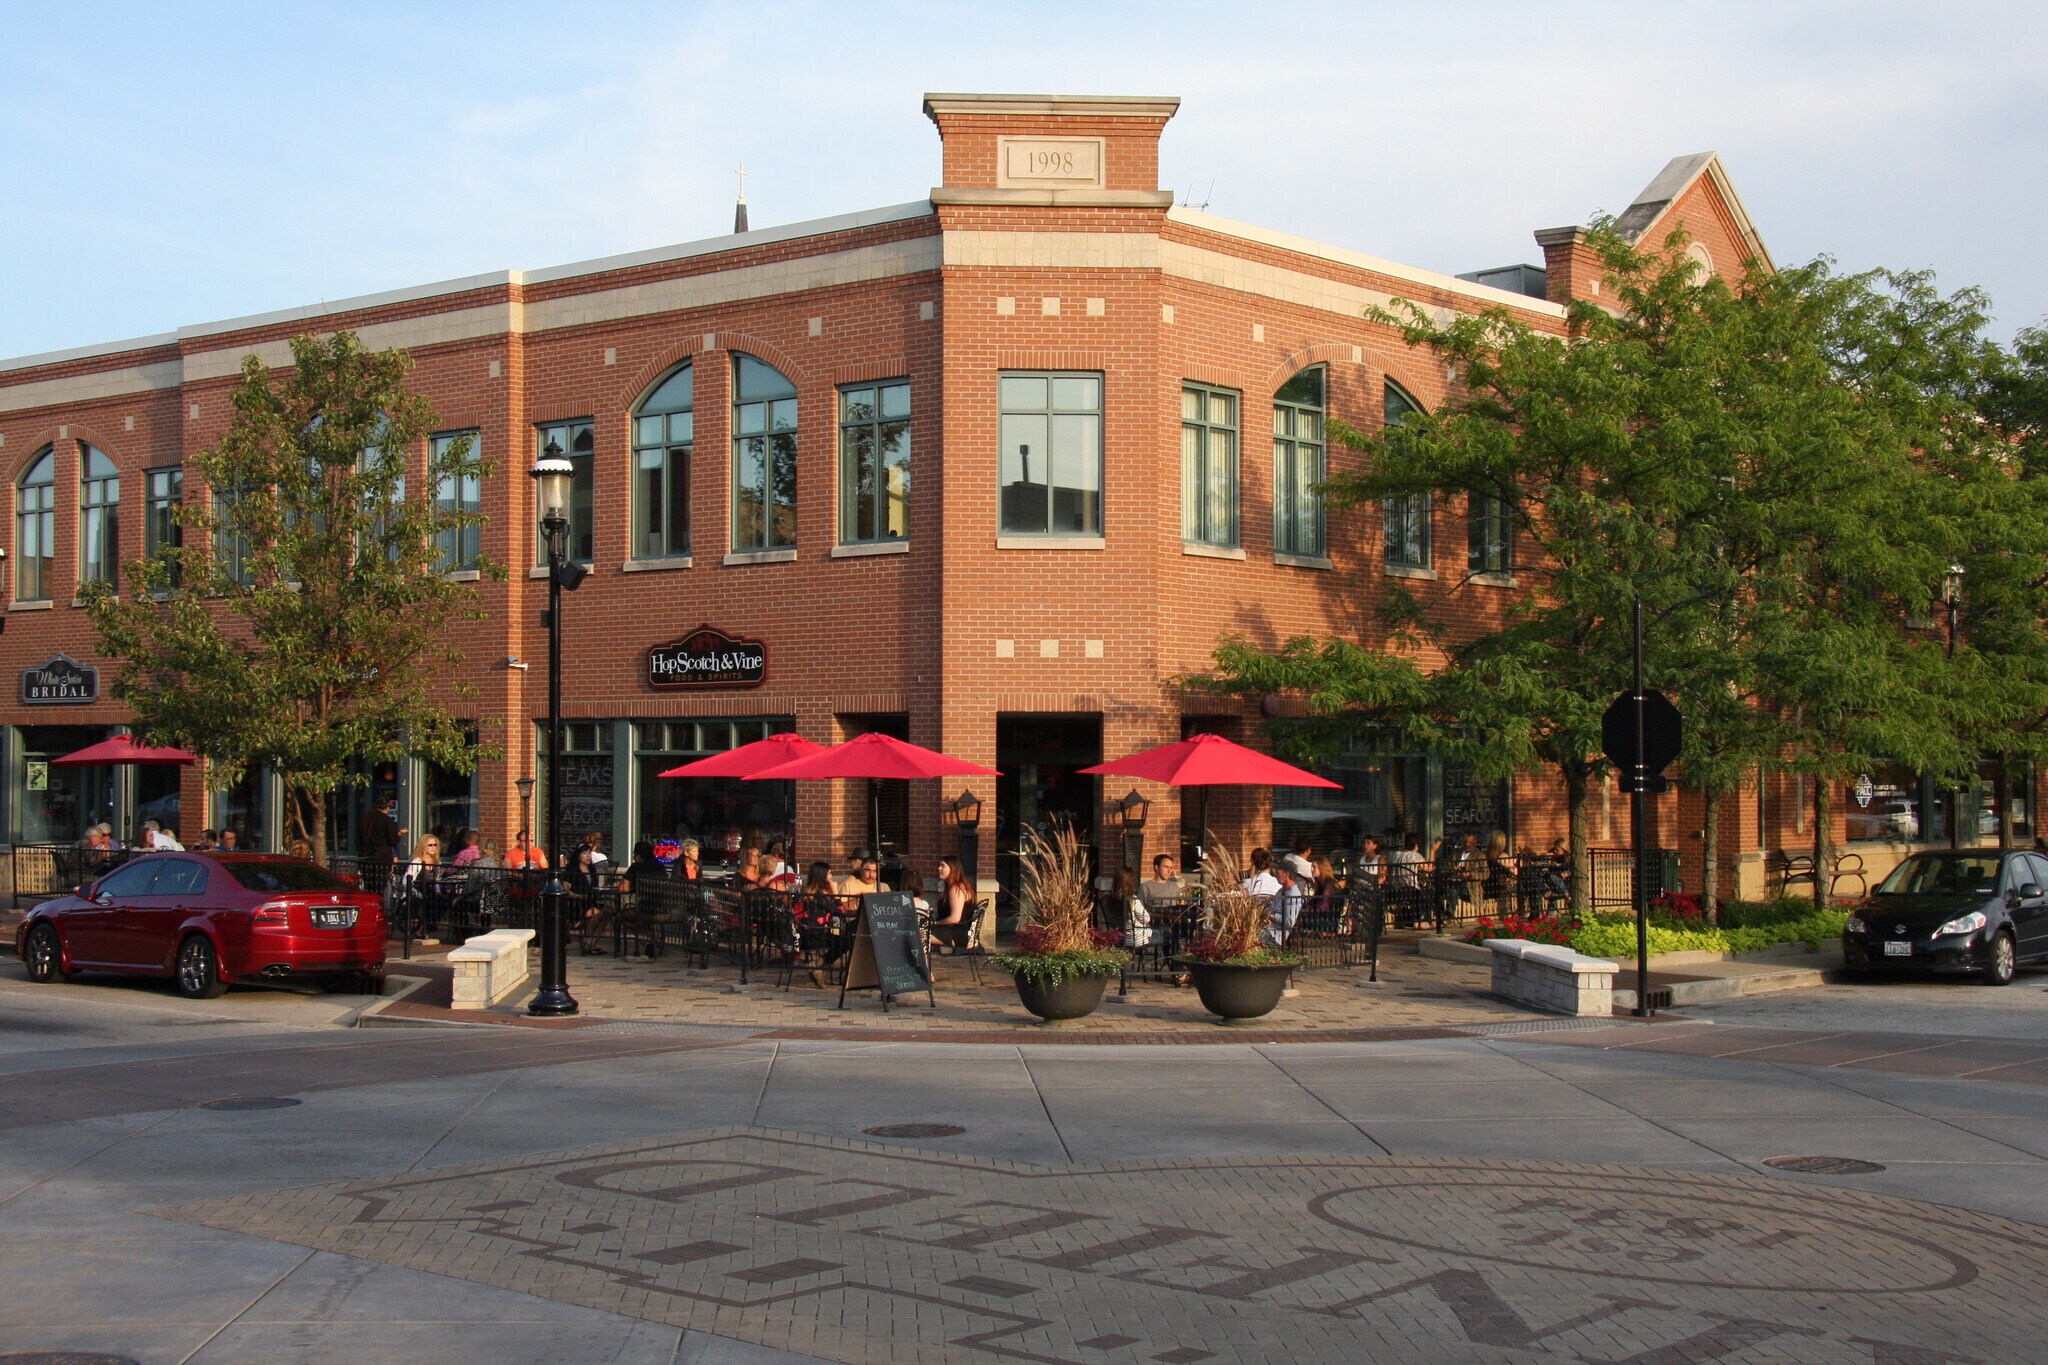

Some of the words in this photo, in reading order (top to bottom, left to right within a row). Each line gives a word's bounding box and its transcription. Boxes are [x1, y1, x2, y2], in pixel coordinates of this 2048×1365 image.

[1027, 151, 1074, 174] 1998
[708, 672, 743, 680] SPIRITS
[32, 686, 88, 698] BRIDAL
[545, 767, 613, 785] EAKS
[1446, 768, 1497, 787] STEA
[545, 808, 613, 824] AFOOD
[1446, 808, 1500, 825] SEAFOOD
[654, 845, 681, 859] OPEN
[872, 903, 904, 917] SPECIAL
[1490, 1195, 1814, 1251] 1834
[552, 1157, 1990, 1365] INFIELD
